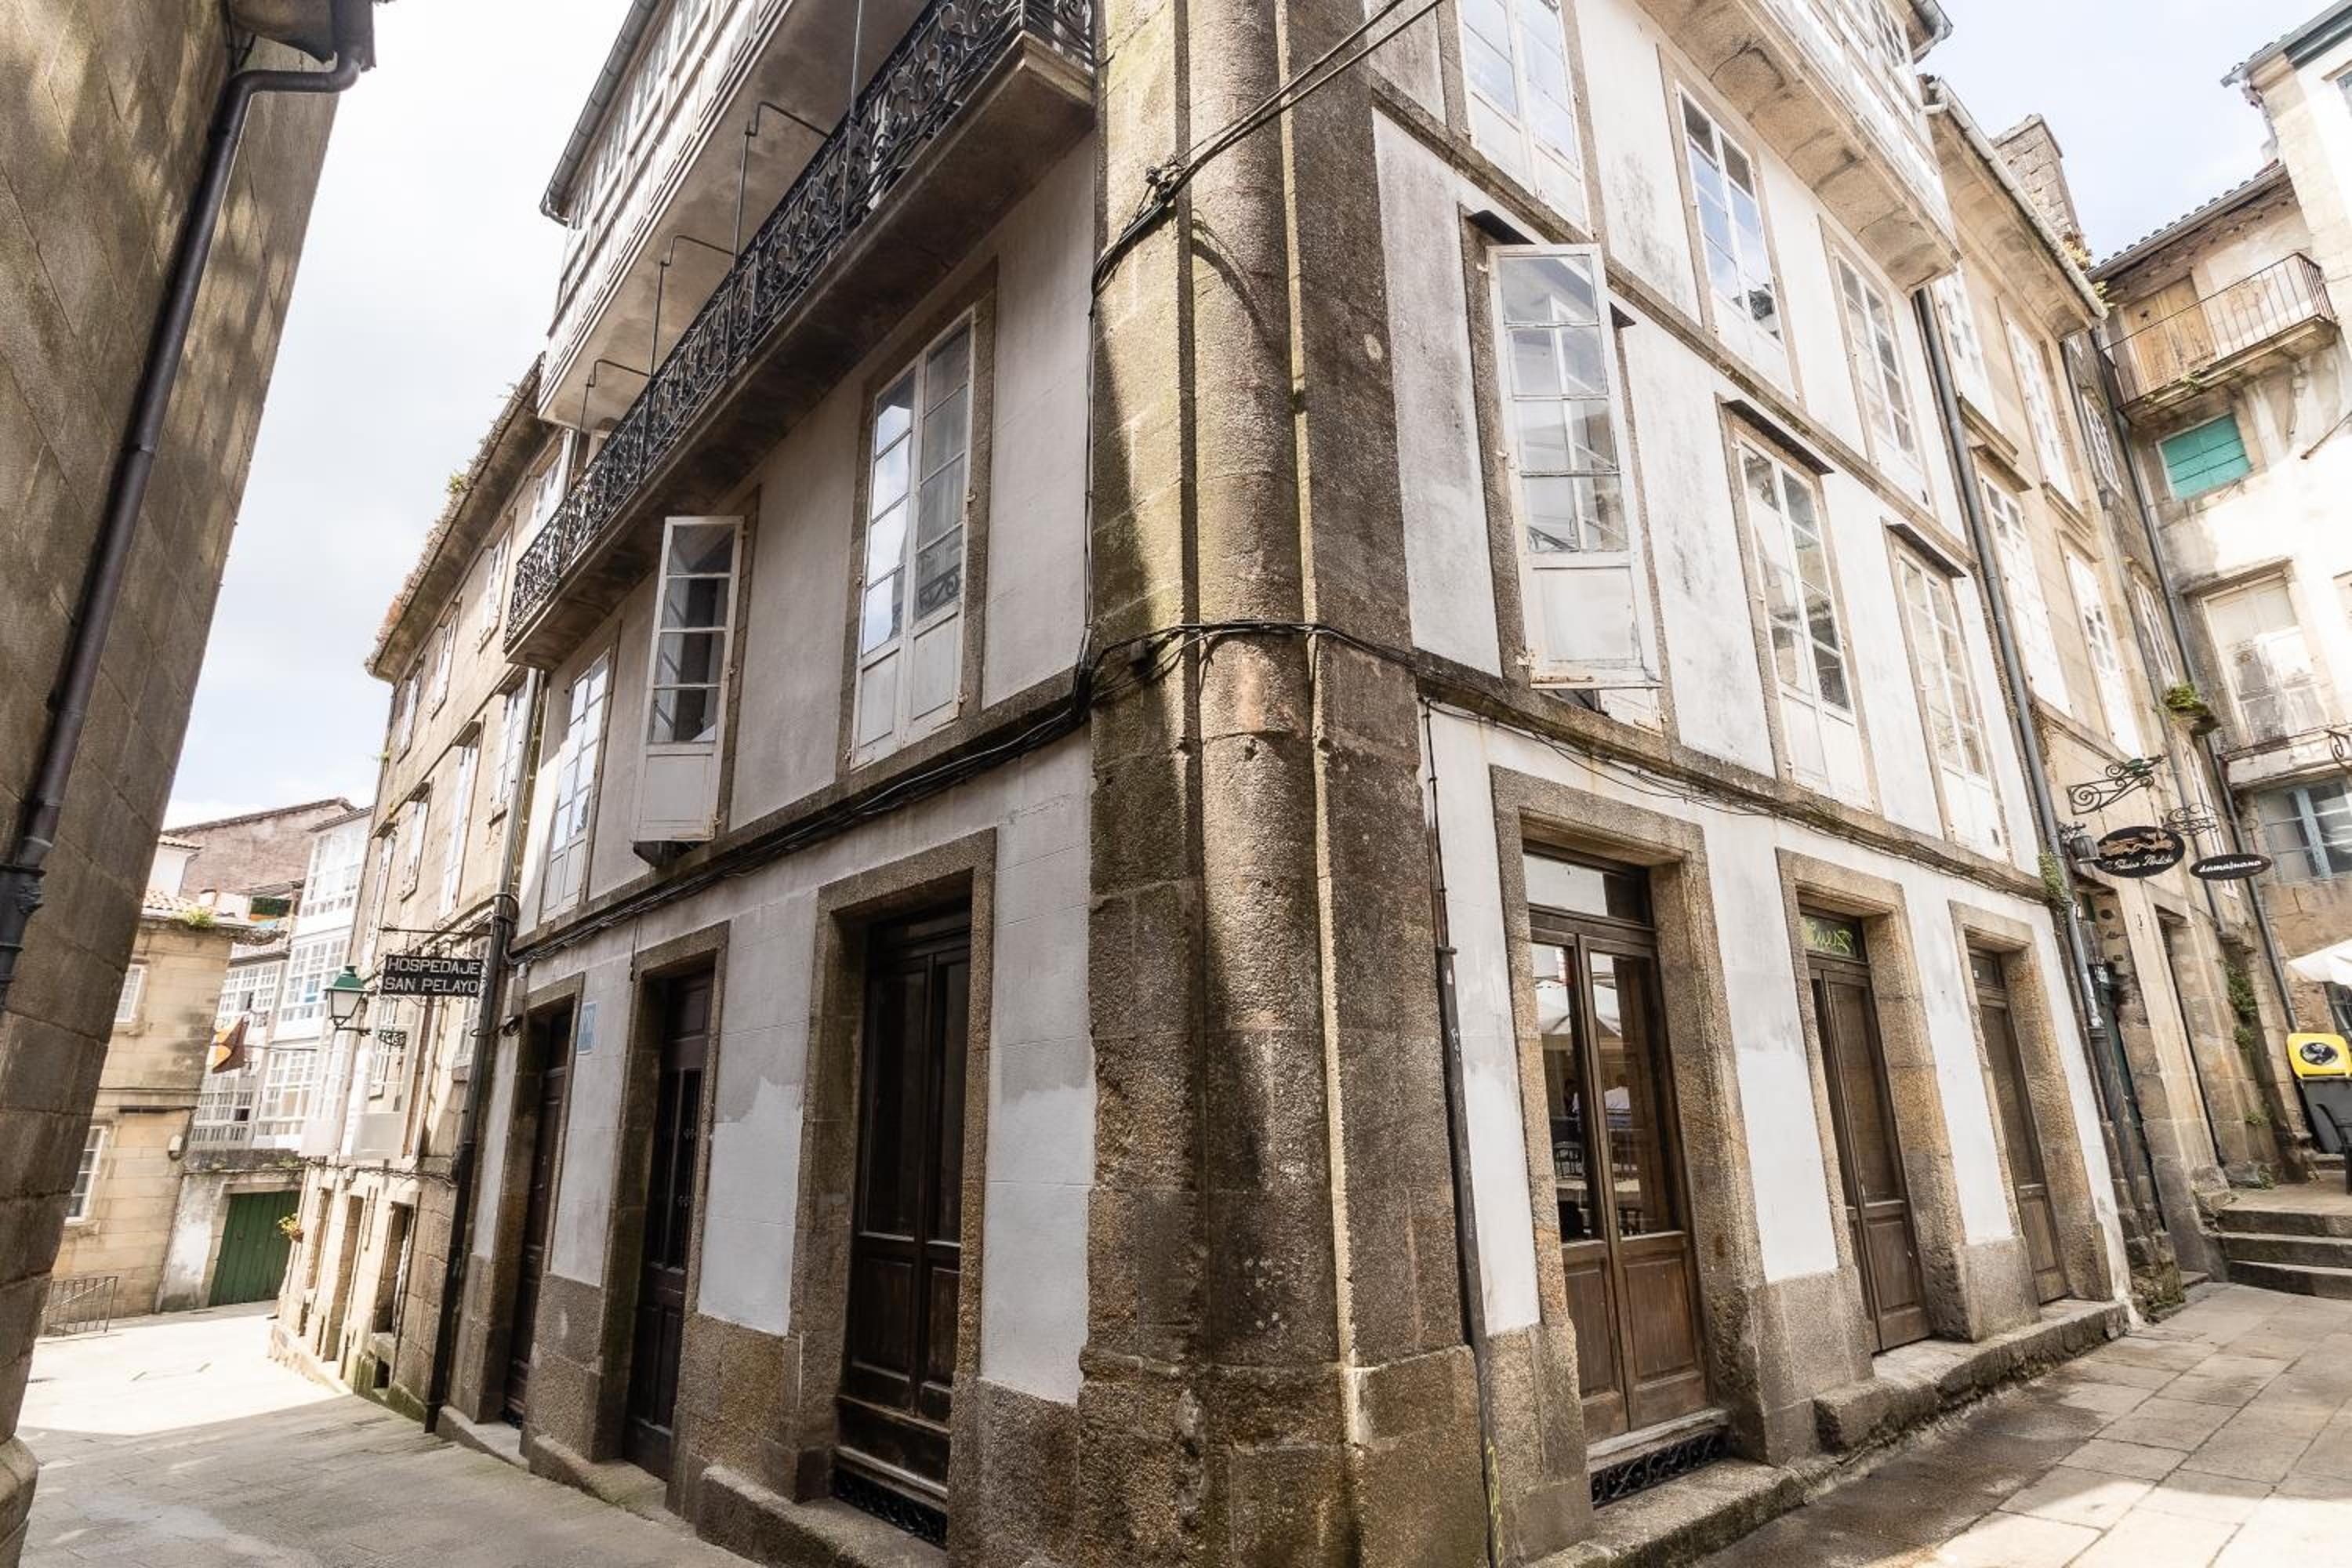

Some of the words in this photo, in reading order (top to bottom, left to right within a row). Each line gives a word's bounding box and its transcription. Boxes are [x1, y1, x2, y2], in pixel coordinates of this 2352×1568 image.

[387, 957, 481, 975] HOSPEDAJE
[384, 977, 416, 992] SAN
[421, 978, 479, 993] PELAYO
